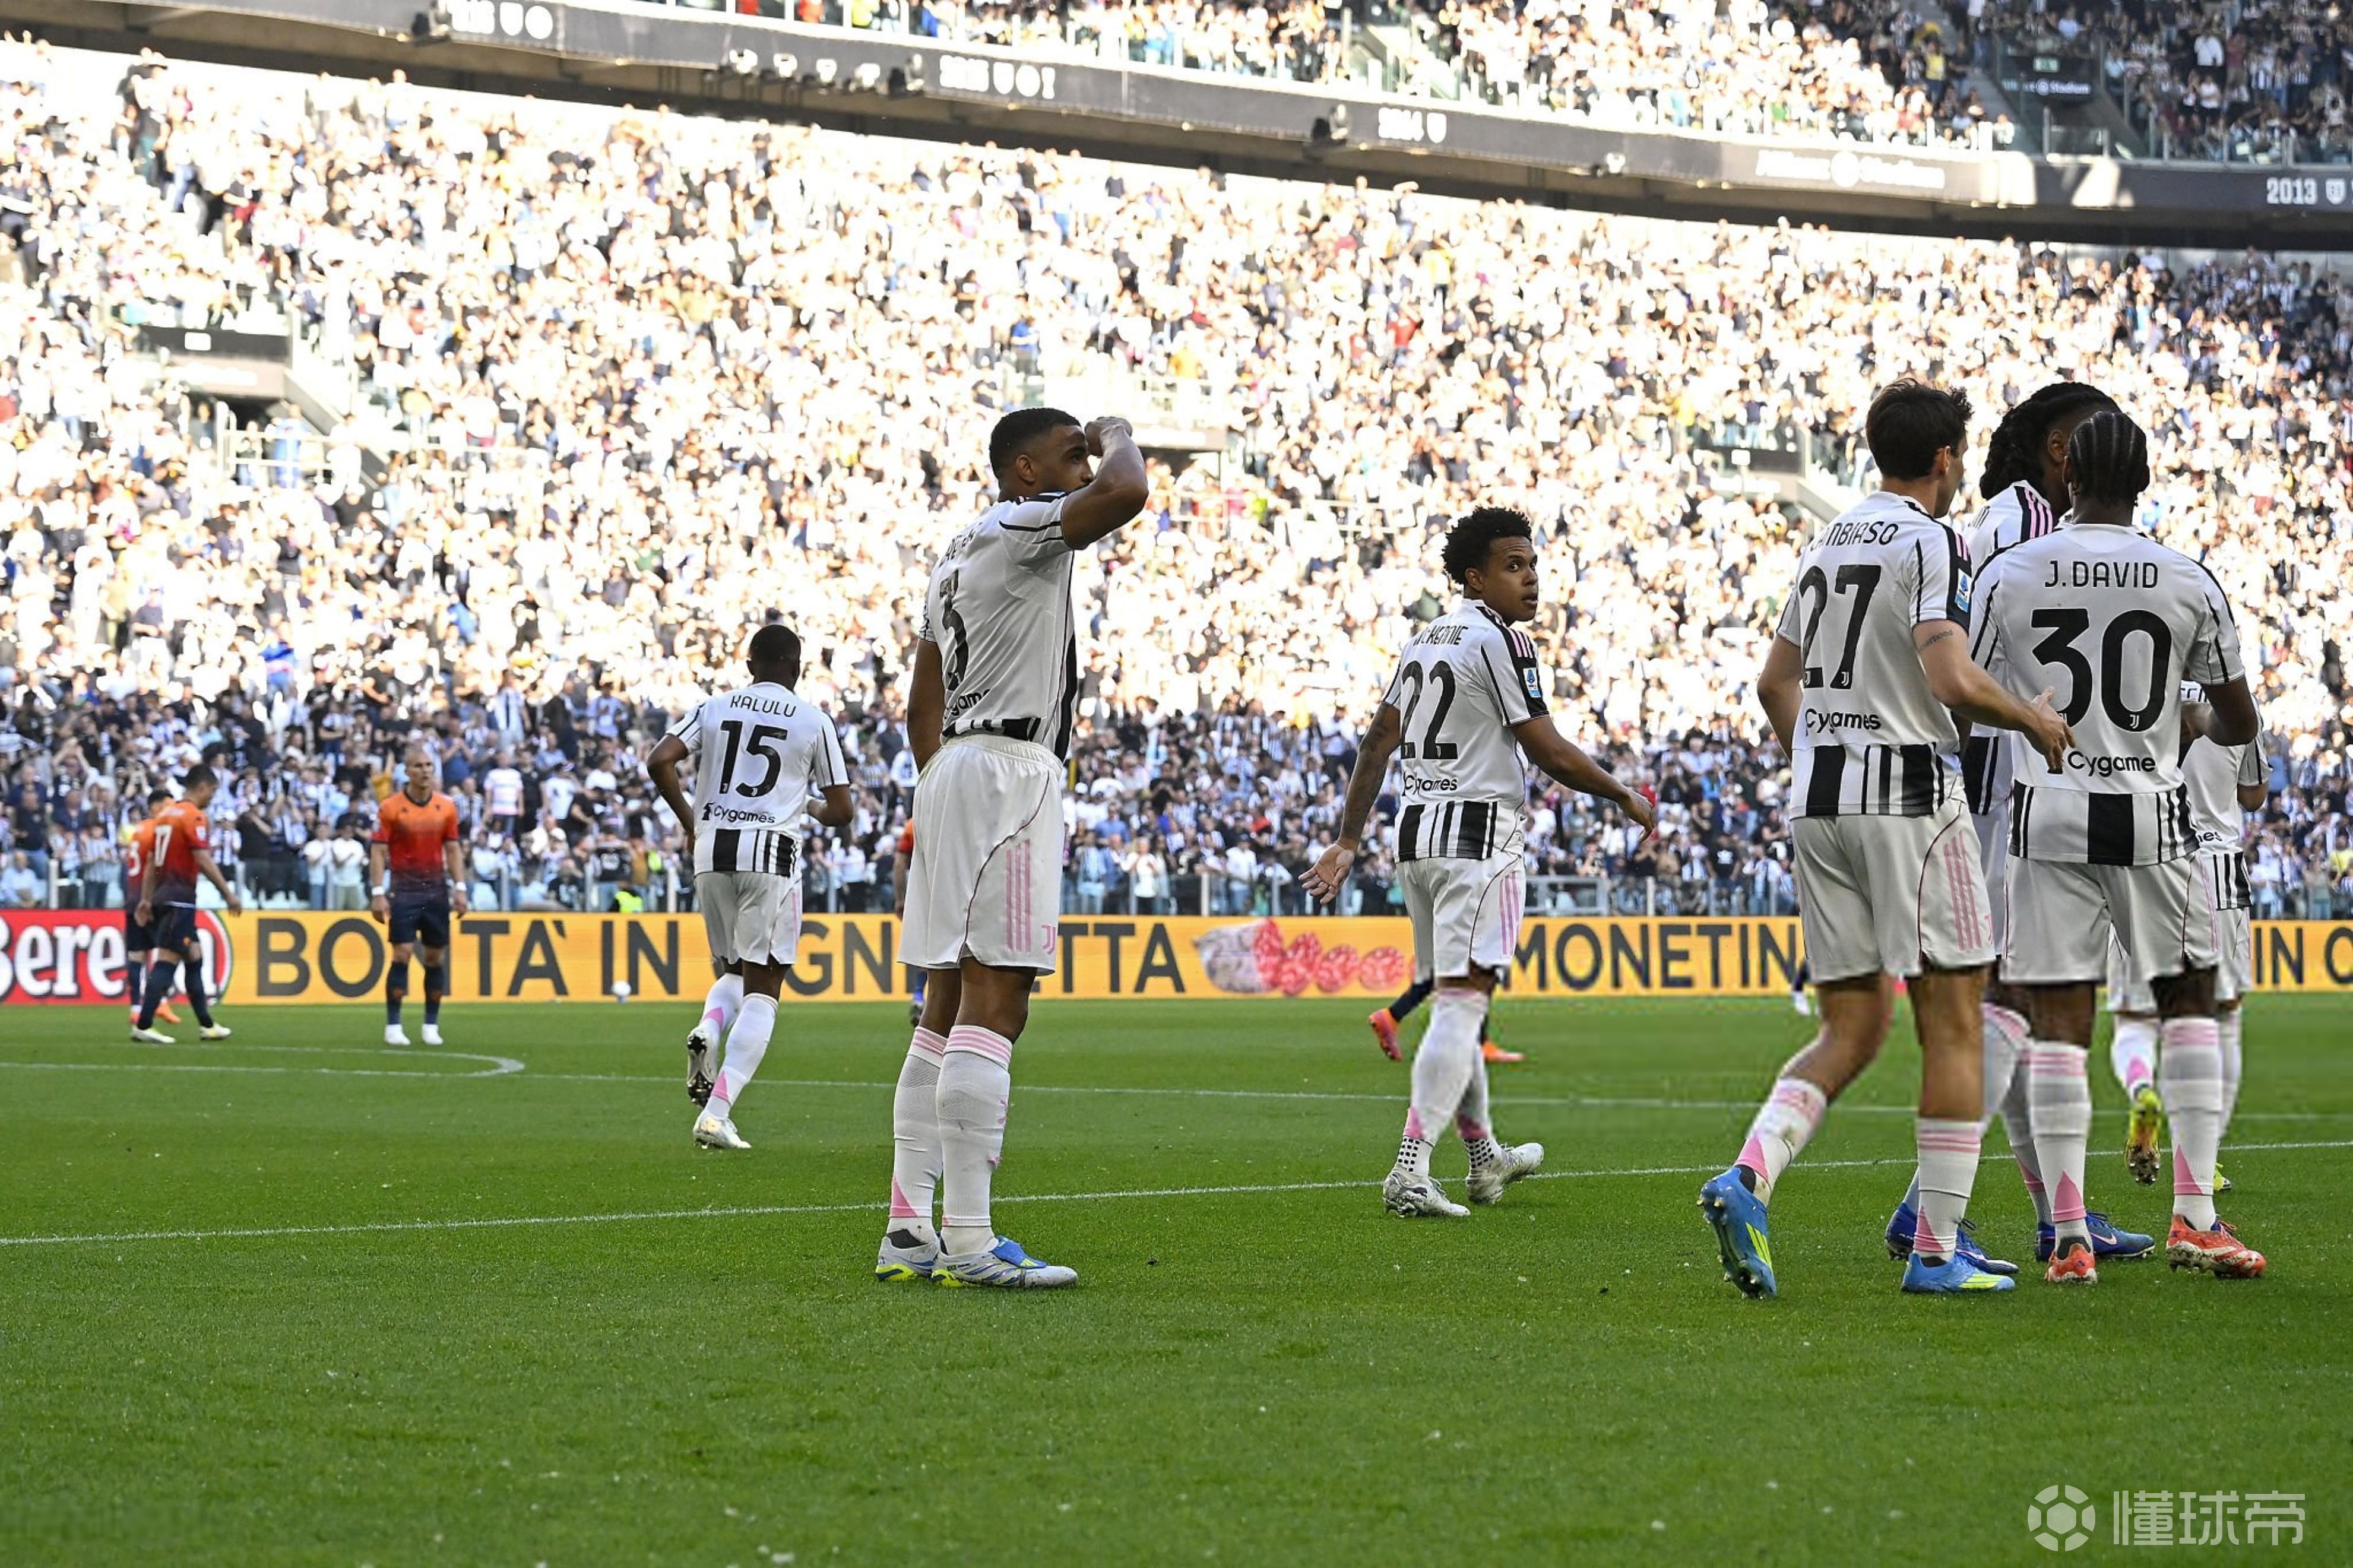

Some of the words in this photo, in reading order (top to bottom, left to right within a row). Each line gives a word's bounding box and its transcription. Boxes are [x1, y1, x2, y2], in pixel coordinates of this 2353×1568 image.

[2266, 177, 2317, 204] 2013
[1798, 565, 1882, 690] 27
[730, 695, 797, 717] KALULU
[2031, 607, 2172, 732] 30
[1401, 660, 1459, 760] 22
[718, 720, 788, 798] 15
[714, 805, 776, 823] Cygames
[601, 920, 679, 995] IN
[2254, 927, 2303, 984] IN
